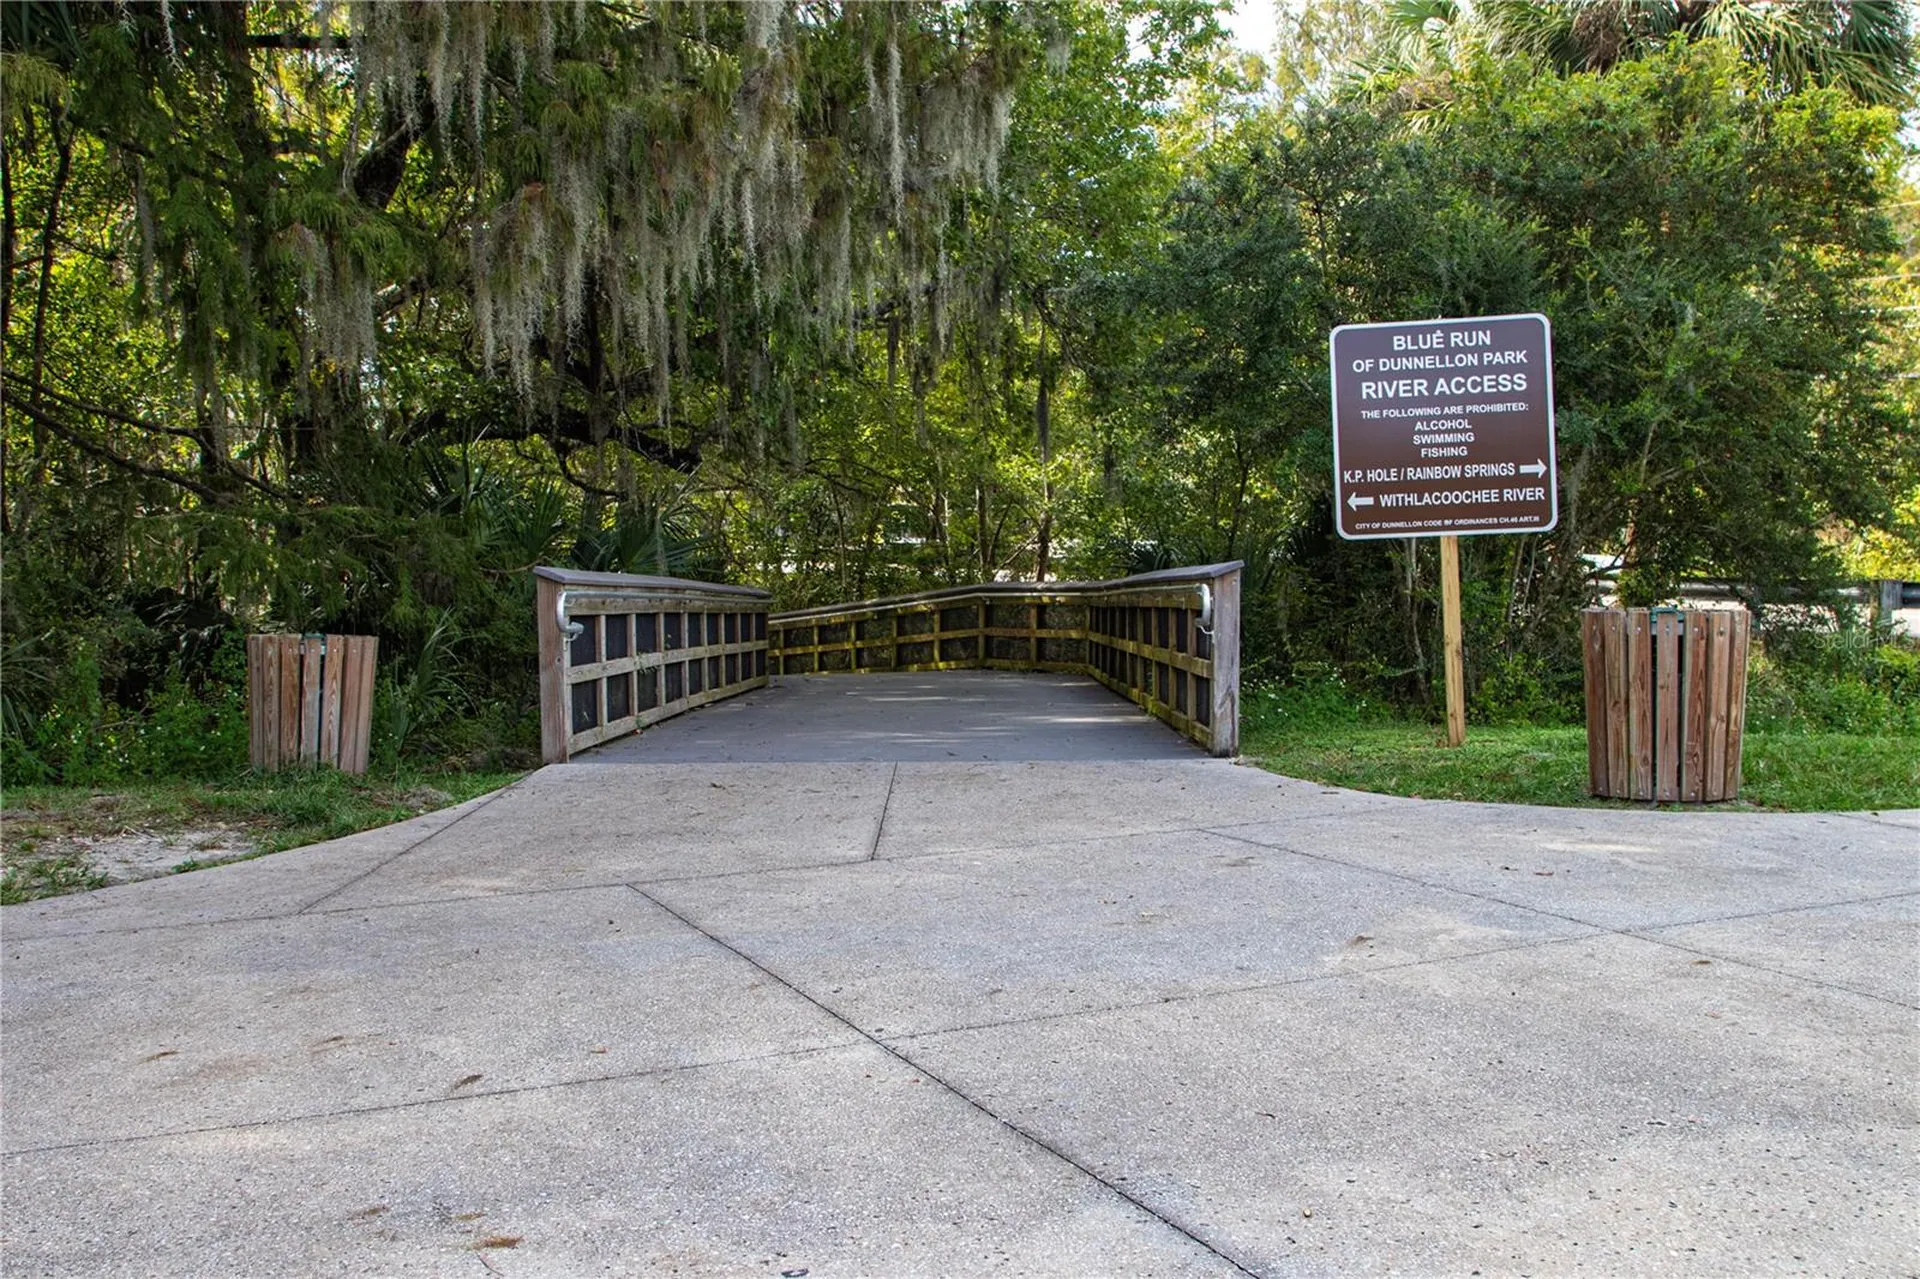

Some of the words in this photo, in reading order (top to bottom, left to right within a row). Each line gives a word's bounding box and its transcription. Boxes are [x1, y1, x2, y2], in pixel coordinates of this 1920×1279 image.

[1393, 334, 1444, 350] BLUE
[1450, 330, 1491, 348] RUN
[1353, 359, 1374, 373] OF
[1379, 353, 1478, 371] DUNNELLON
[1483, 350, 1528, 365] PARK
[1361, 379, 1429, 399] RIVER
[1434, 373, 1527, 396] ACCESS
[1361, 410, 1380, 419] THE
[1383, 407, 1441, 418] FOLLOWING
[1443, 405, 1464, 415] ARE
[1466, 402, 1529, 413] PROHIBITED:
[1414, 419, 1472, 431] ALCOHOL
[1413, 432, 1475, 445] SWIMMING
[1421, 446, 1467, 458] FISHING
[1343, 470, 1364, 483] K.P.
[1367, 468, 1398, 482] HOLE
[1407, 465, 1461, 480] RAINBOW
[1464, 462, 1515, 478] SPRINGS
[1379, 490, 1500, 507] WITHLACOOCHEE
[1503, 487, 1545, 502] RIVER
[1355, 522, 1370, 530] CITY
[1371, 521, 1380, 529] OF
[1382, 520, 1422, 529] DUNNELLON
[1423, 519, 1442, 527] CODE
[1454, 517, 1498, 525] ORDINANCES
